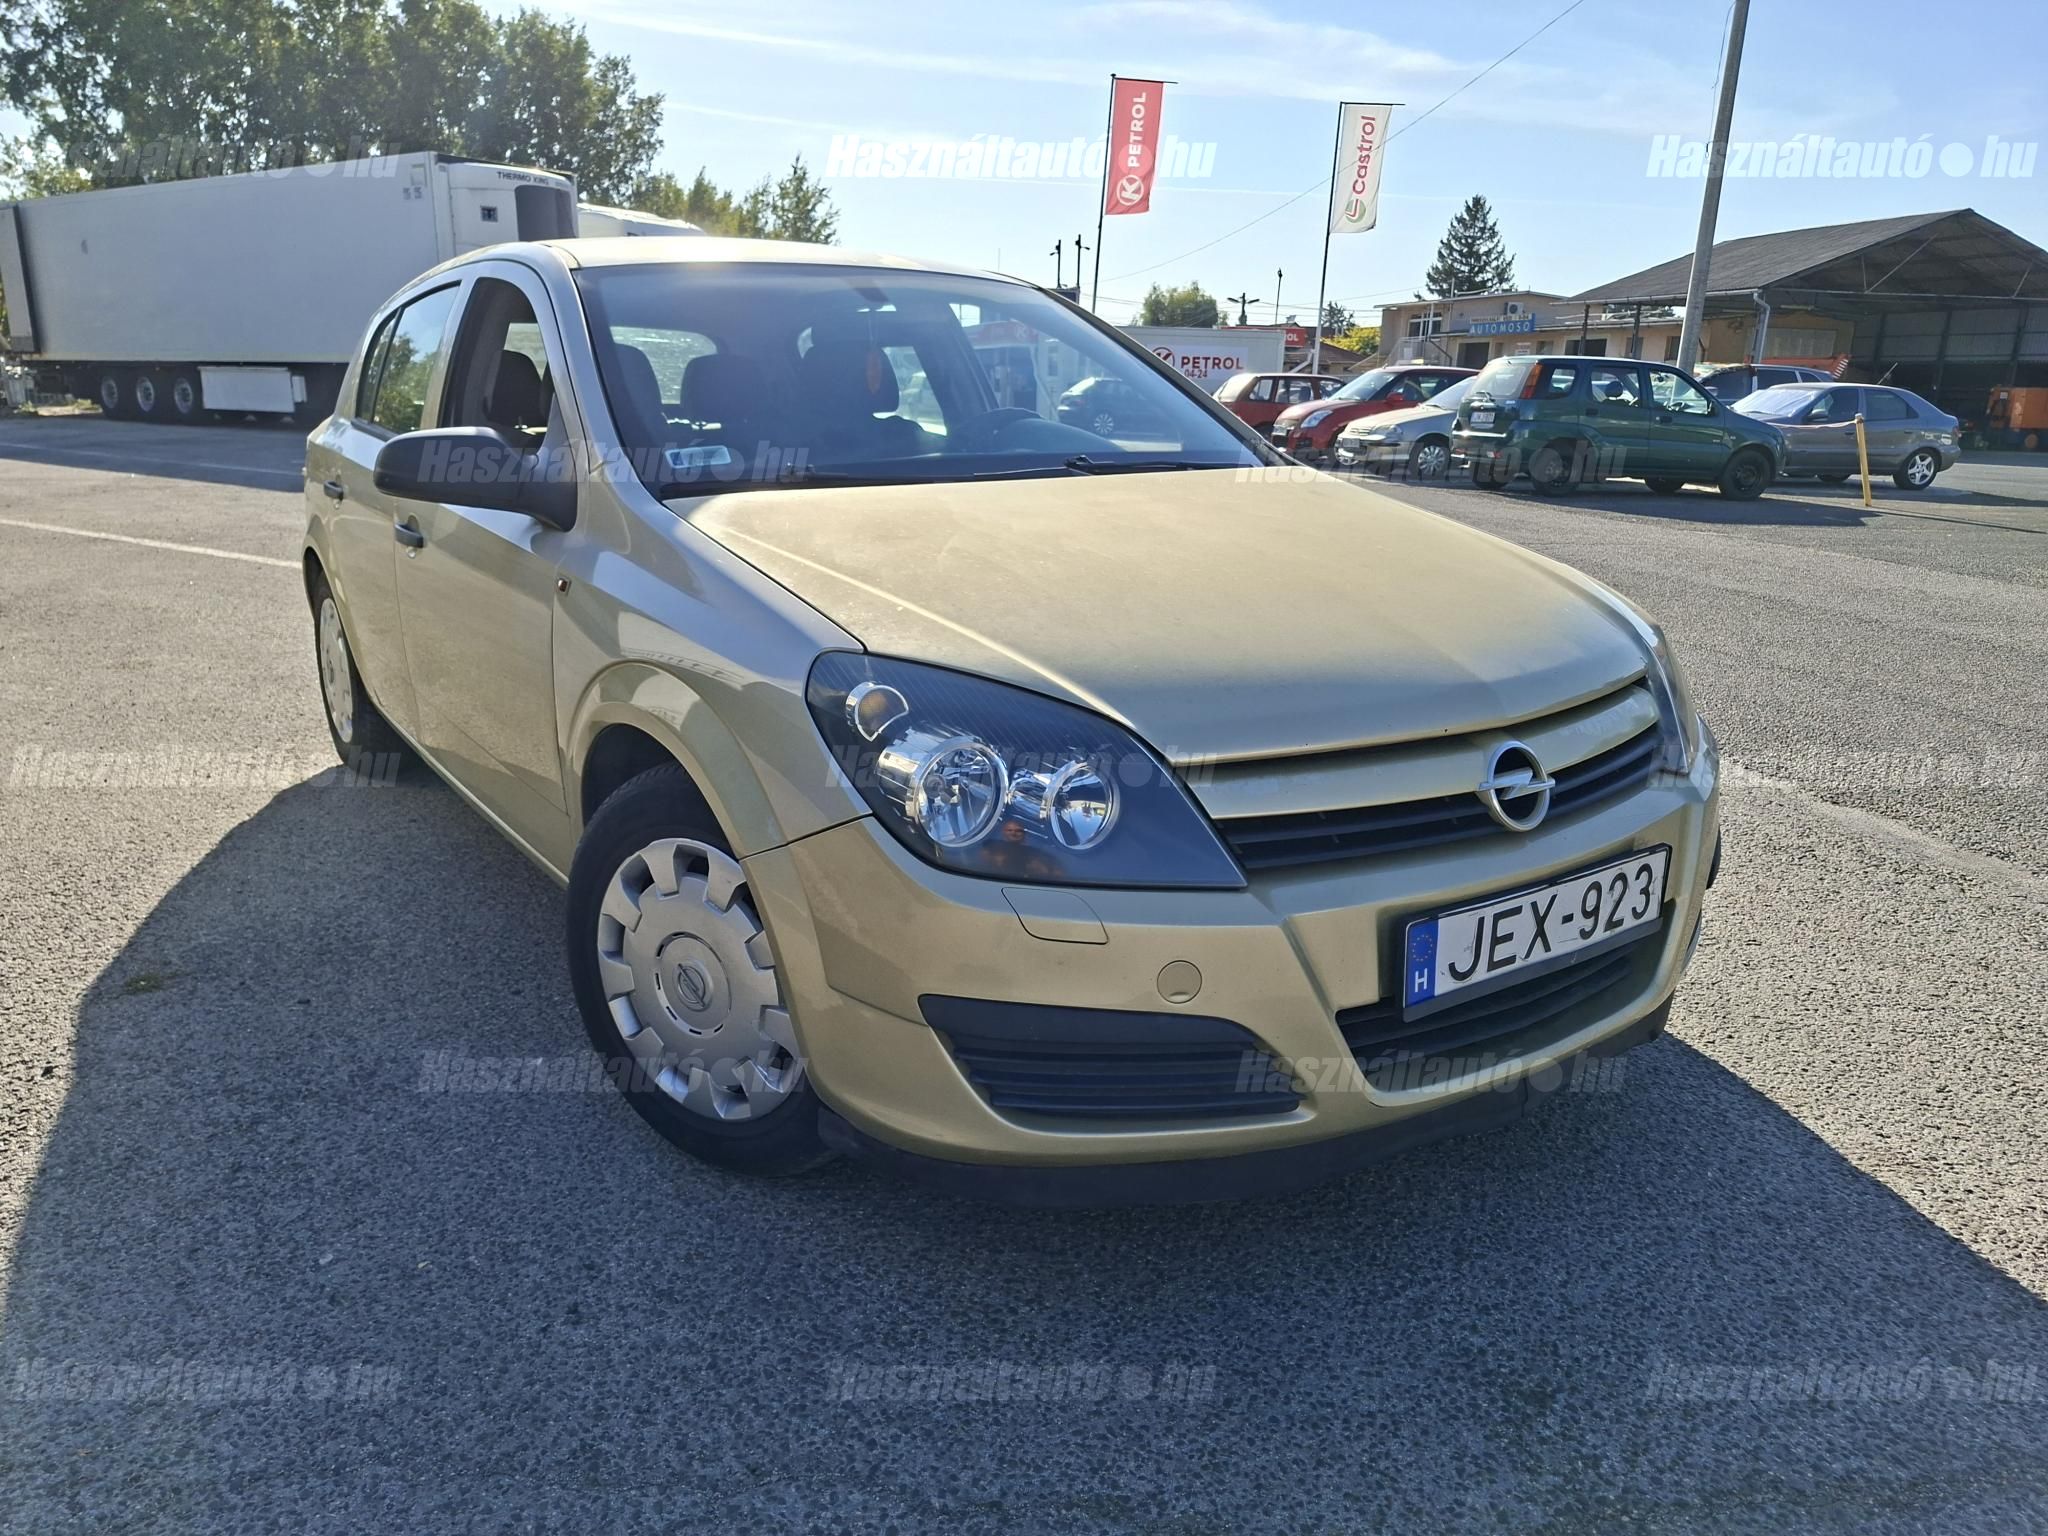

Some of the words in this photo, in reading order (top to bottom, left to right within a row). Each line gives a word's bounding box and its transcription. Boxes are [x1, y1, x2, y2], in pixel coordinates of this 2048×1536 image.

[1127, 91, 1147, 168] PETROL
[1352, 115, 1377, 195] Castrol
[1181, 356, 1244, 370] PETROL
[1448, 862, 1653, 983] JEX-923
[1414, 967, 1429, 993] H
